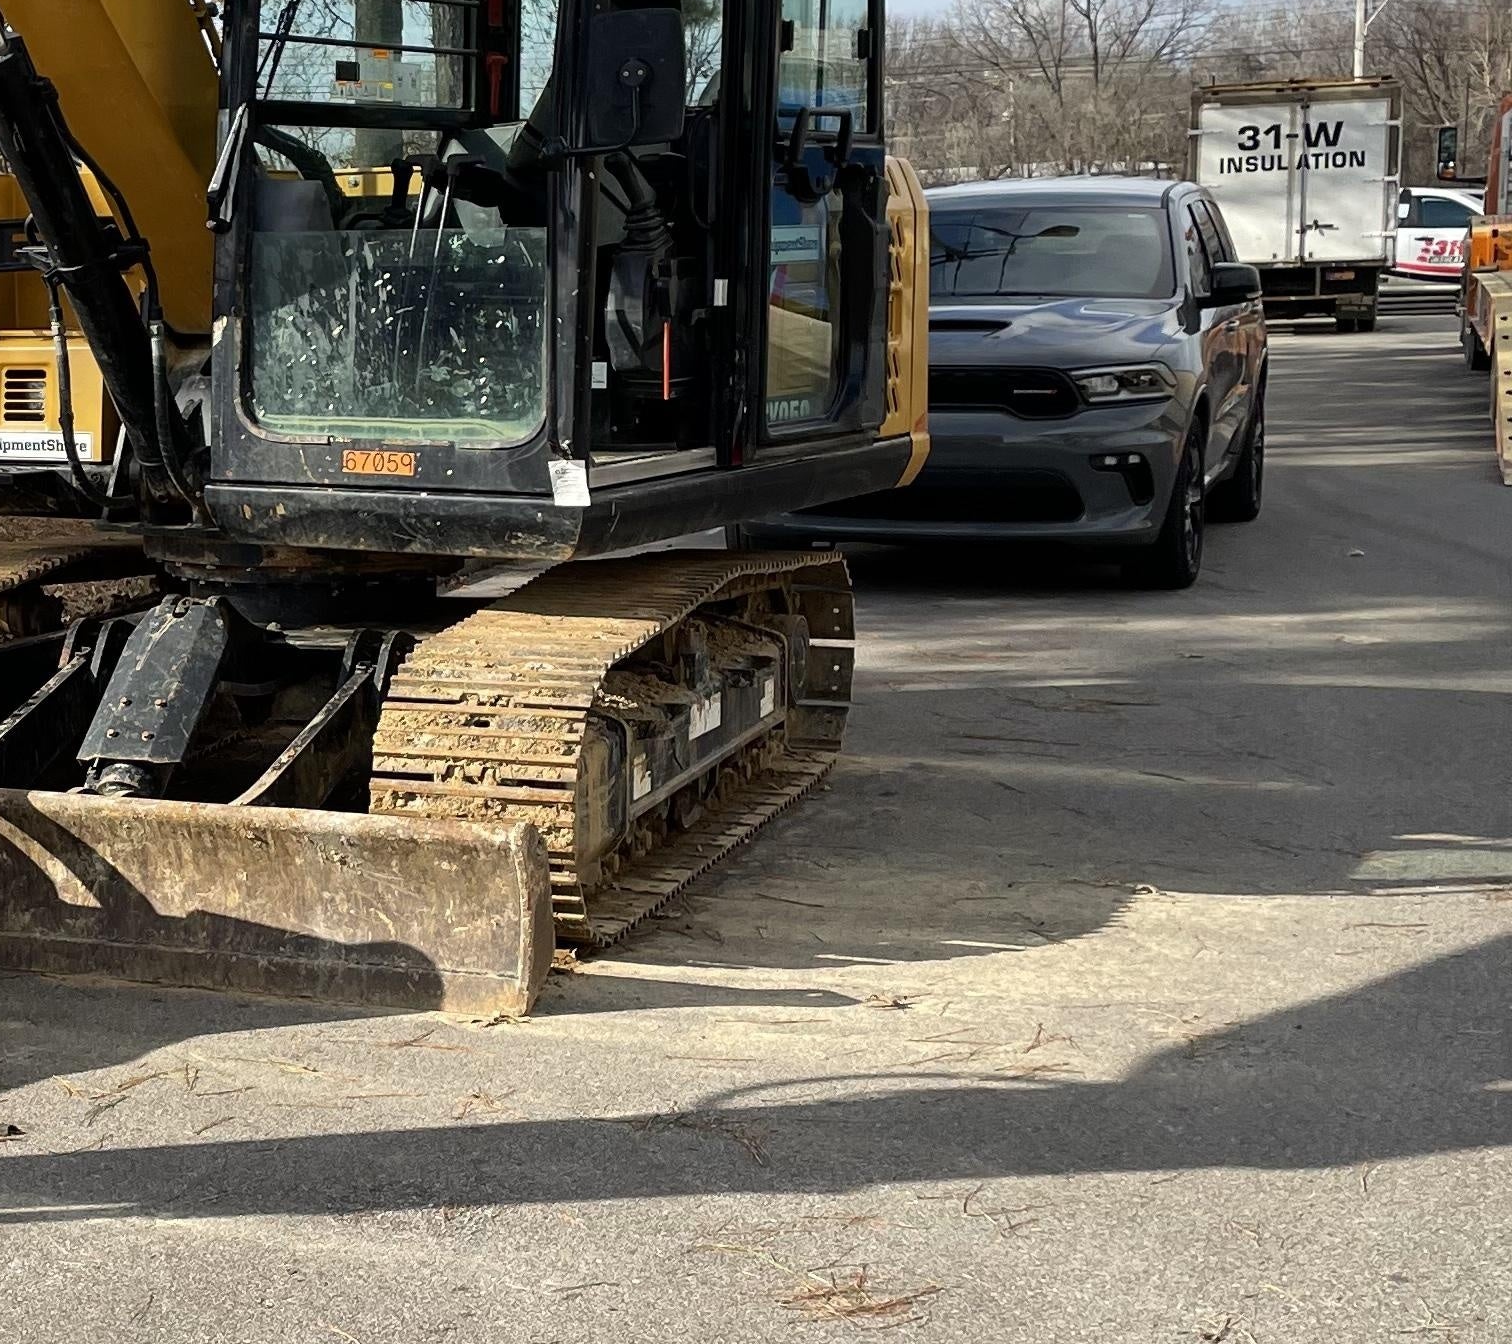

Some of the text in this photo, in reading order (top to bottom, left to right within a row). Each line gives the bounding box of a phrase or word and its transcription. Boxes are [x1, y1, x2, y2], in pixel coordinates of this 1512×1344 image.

[1238, 121, 1344, 151] 31-W
[1219, 151, 1365, 174] INSULATION
[346, 451, 412, 473] 67059
